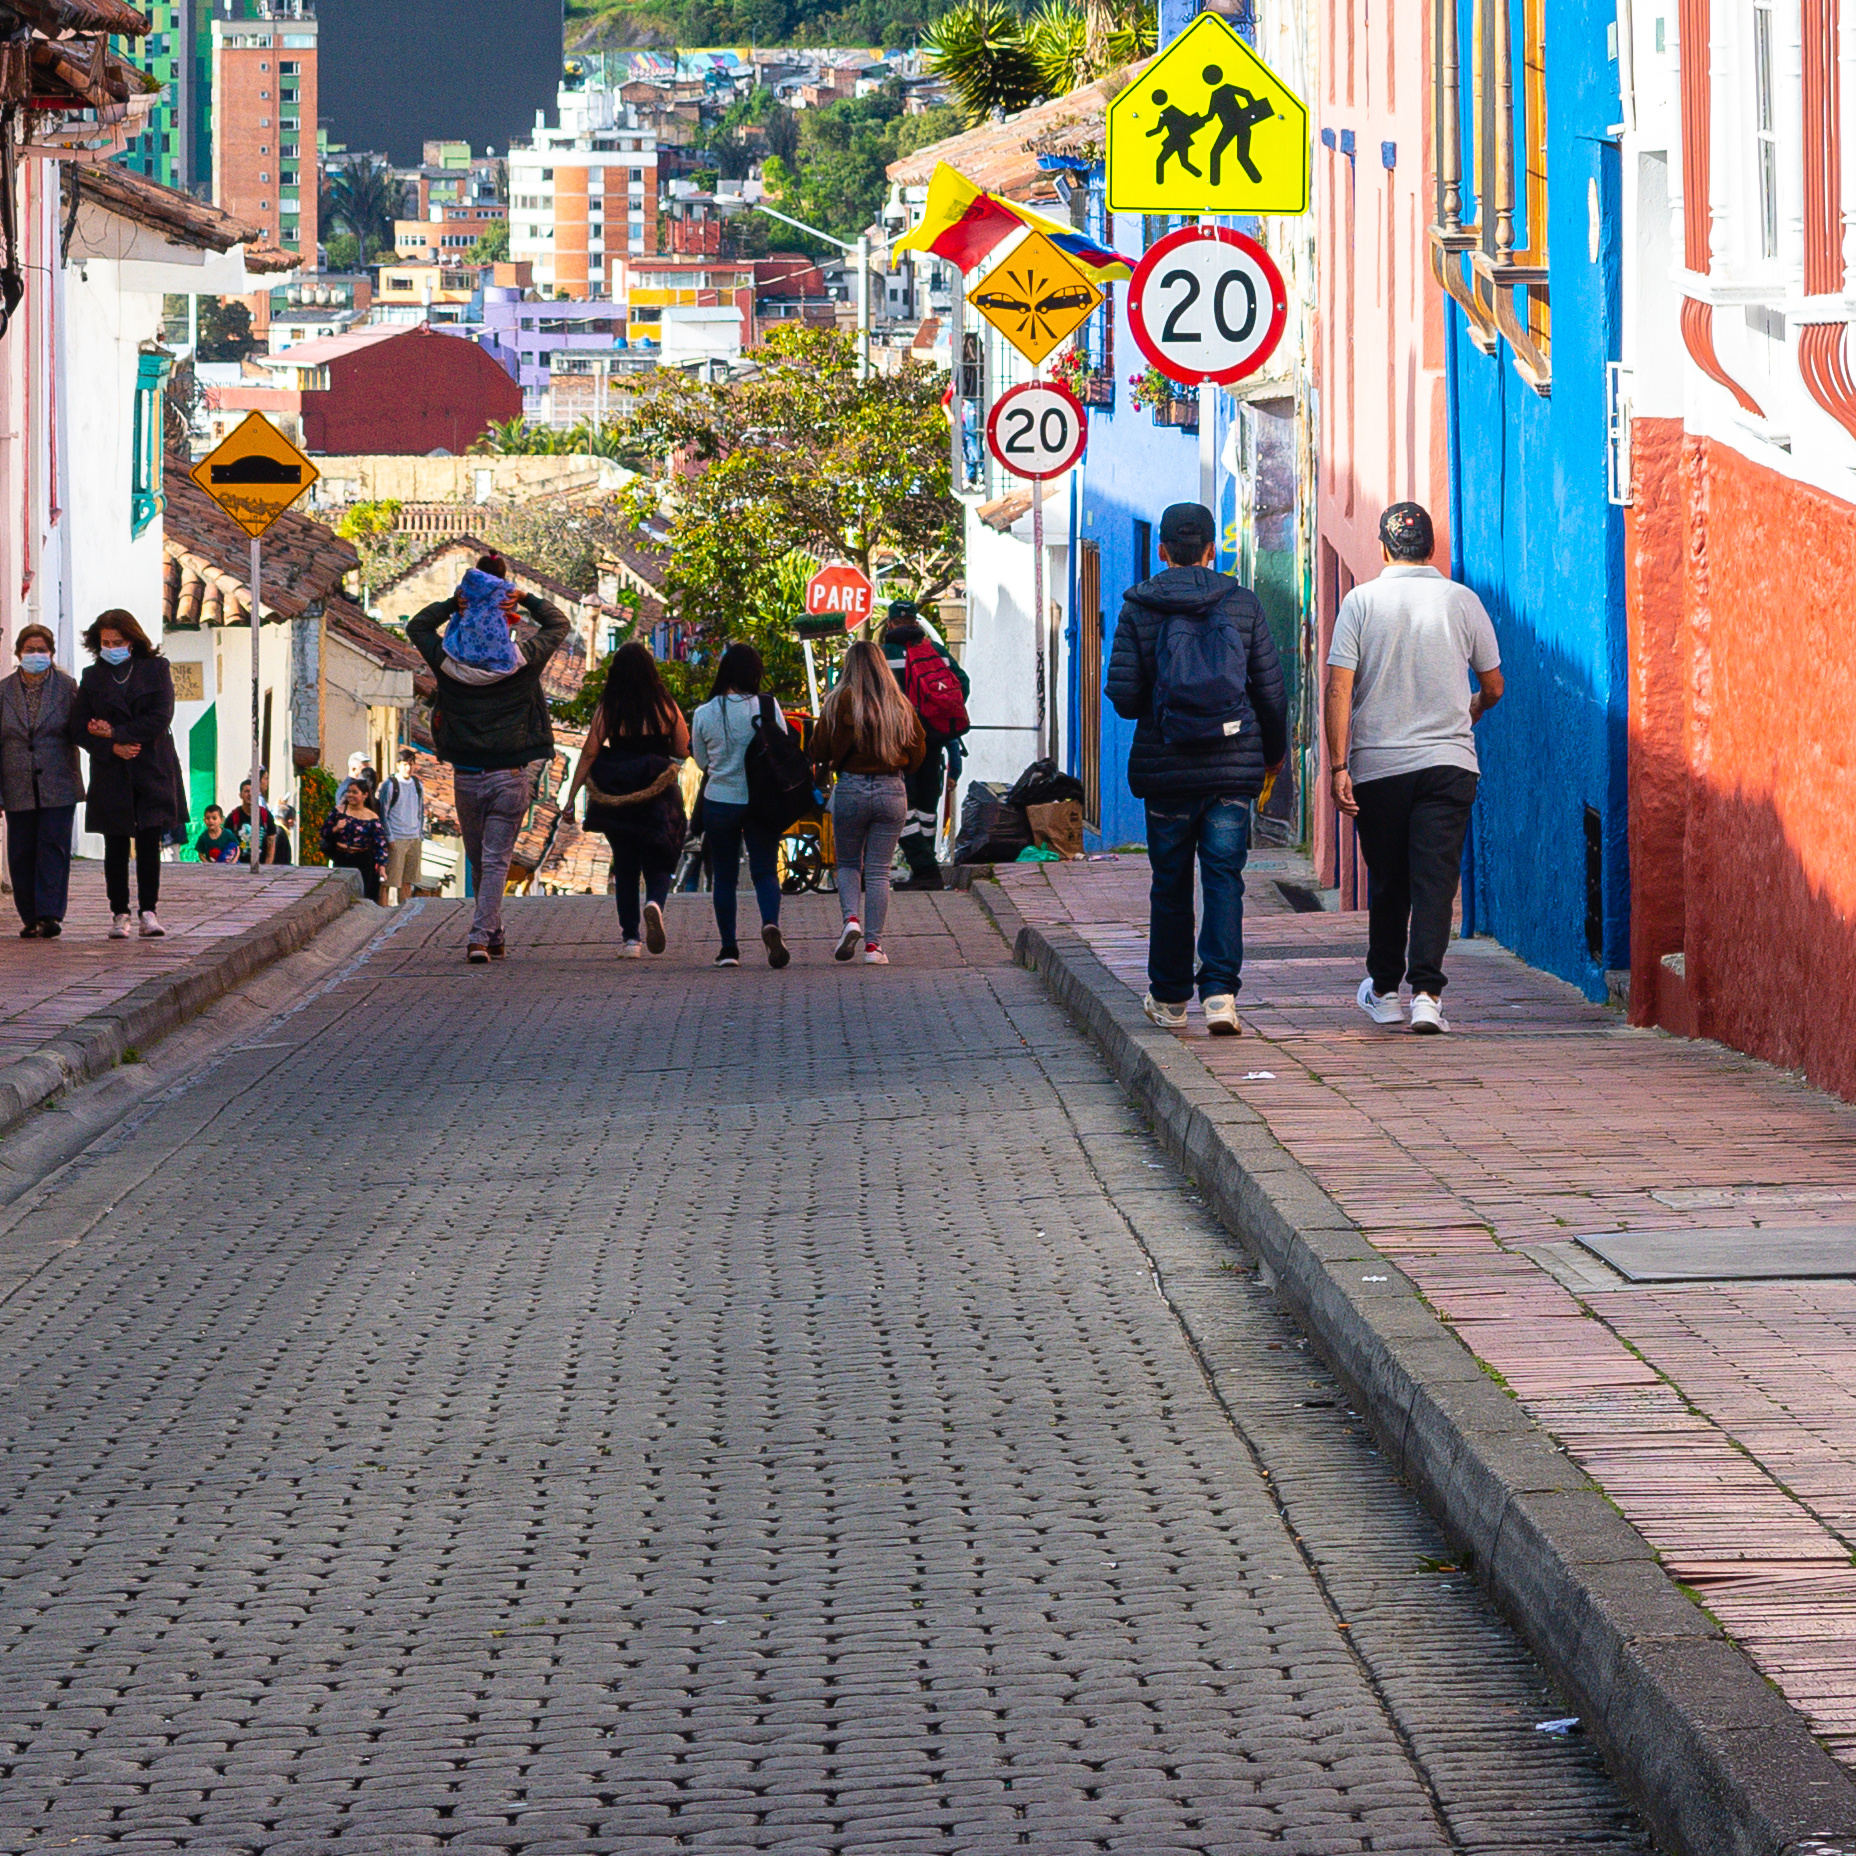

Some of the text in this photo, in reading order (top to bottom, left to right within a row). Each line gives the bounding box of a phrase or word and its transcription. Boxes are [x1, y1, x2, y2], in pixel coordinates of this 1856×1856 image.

[1160, 269, 1257, 342] 20
[1005, 407, 1068, 453] 20
[813, 584, 867, 612] PARE
